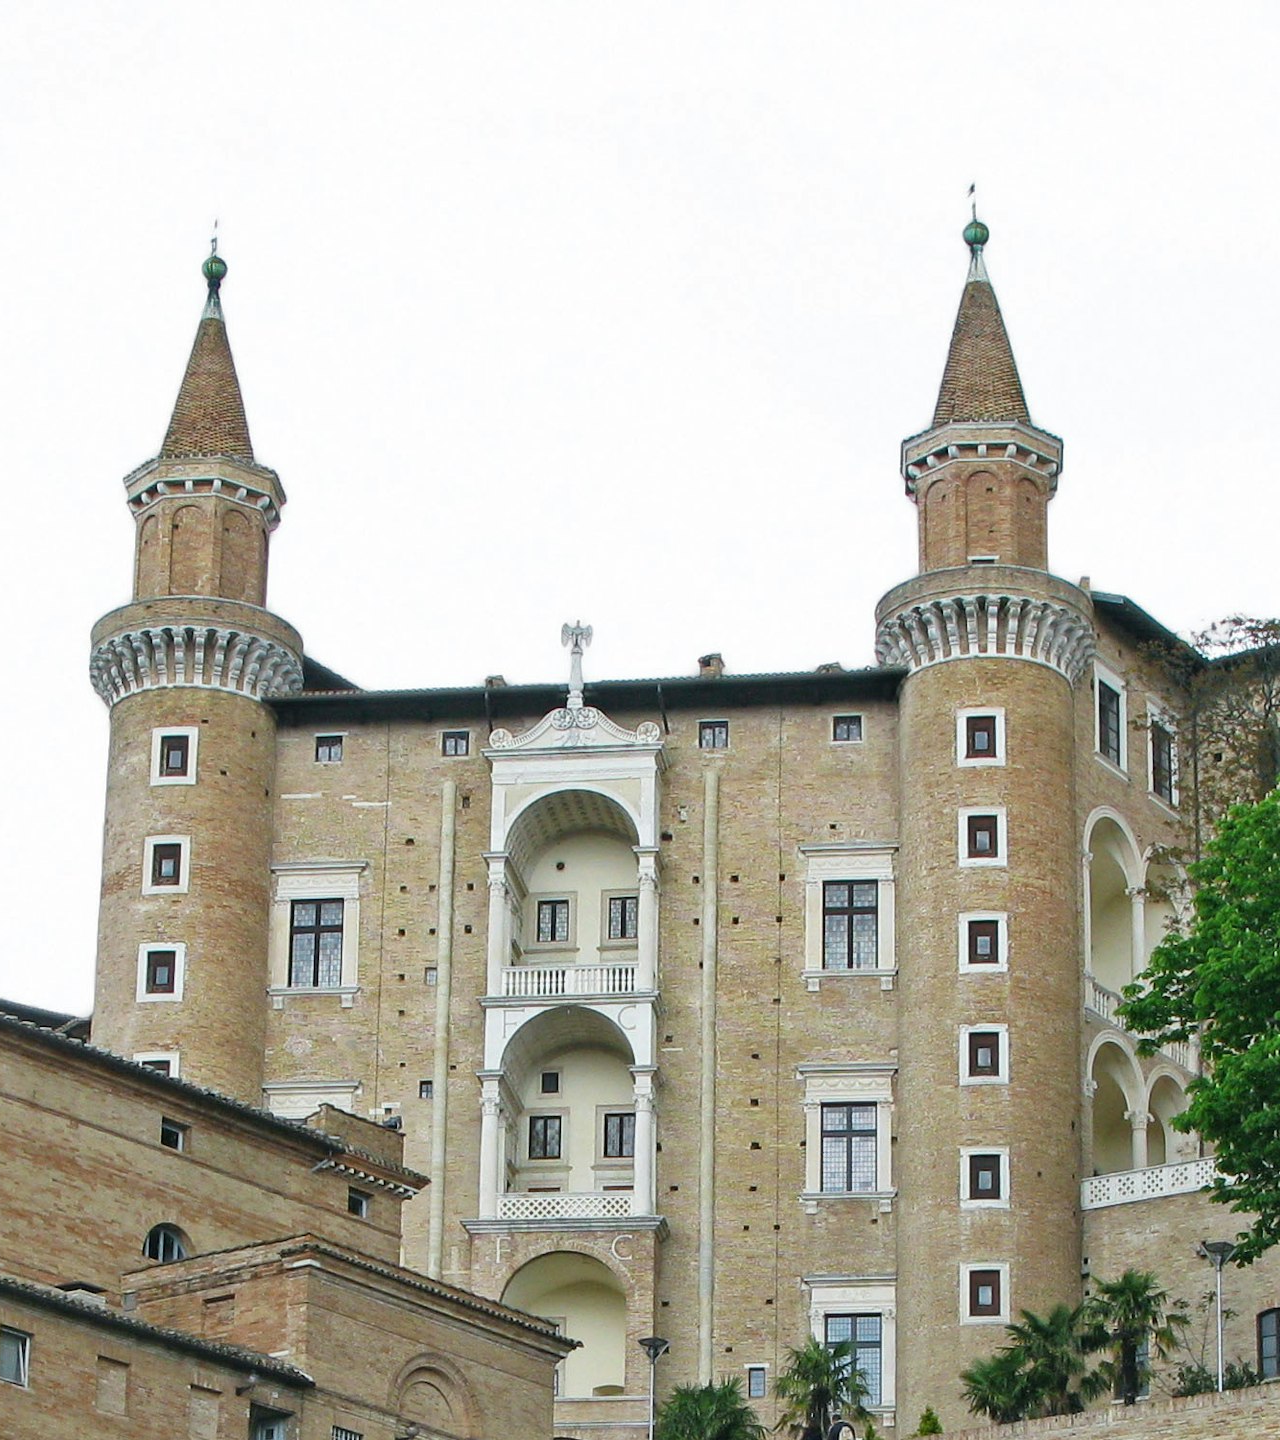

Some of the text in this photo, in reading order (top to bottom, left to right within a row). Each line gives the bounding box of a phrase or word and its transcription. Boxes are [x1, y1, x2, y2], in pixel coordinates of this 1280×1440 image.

[502, 1005, 637, 1039] F C
[495, 1234, 633, 1264] F C
